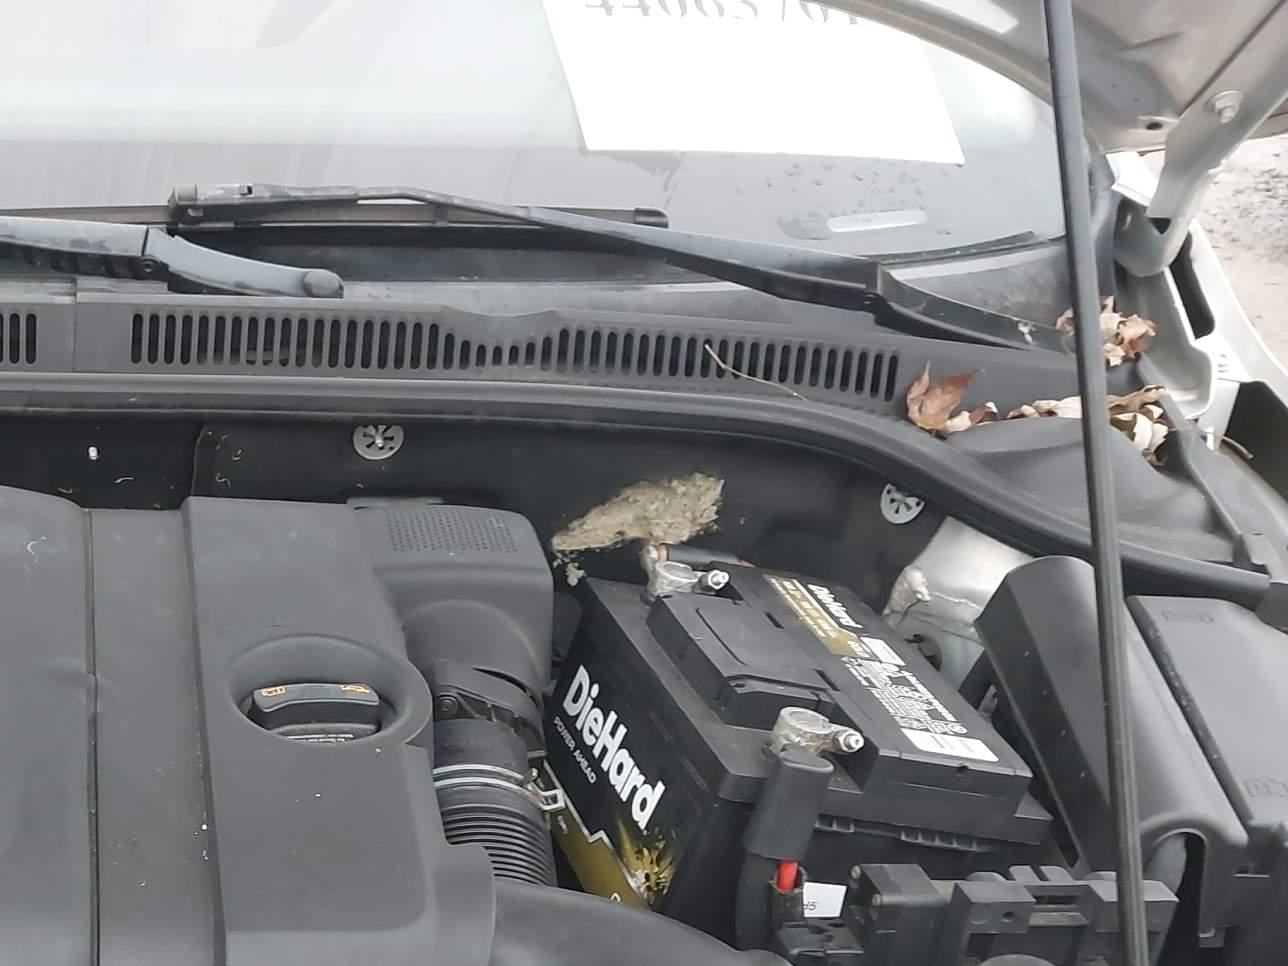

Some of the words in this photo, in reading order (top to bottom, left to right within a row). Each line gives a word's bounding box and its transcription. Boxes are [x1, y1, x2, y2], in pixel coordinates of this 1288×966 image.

[553, 715, 577, 752] POWER
[572, 748, 598, 785] AHEAD
[562, 663, 667, 831] DieHard
